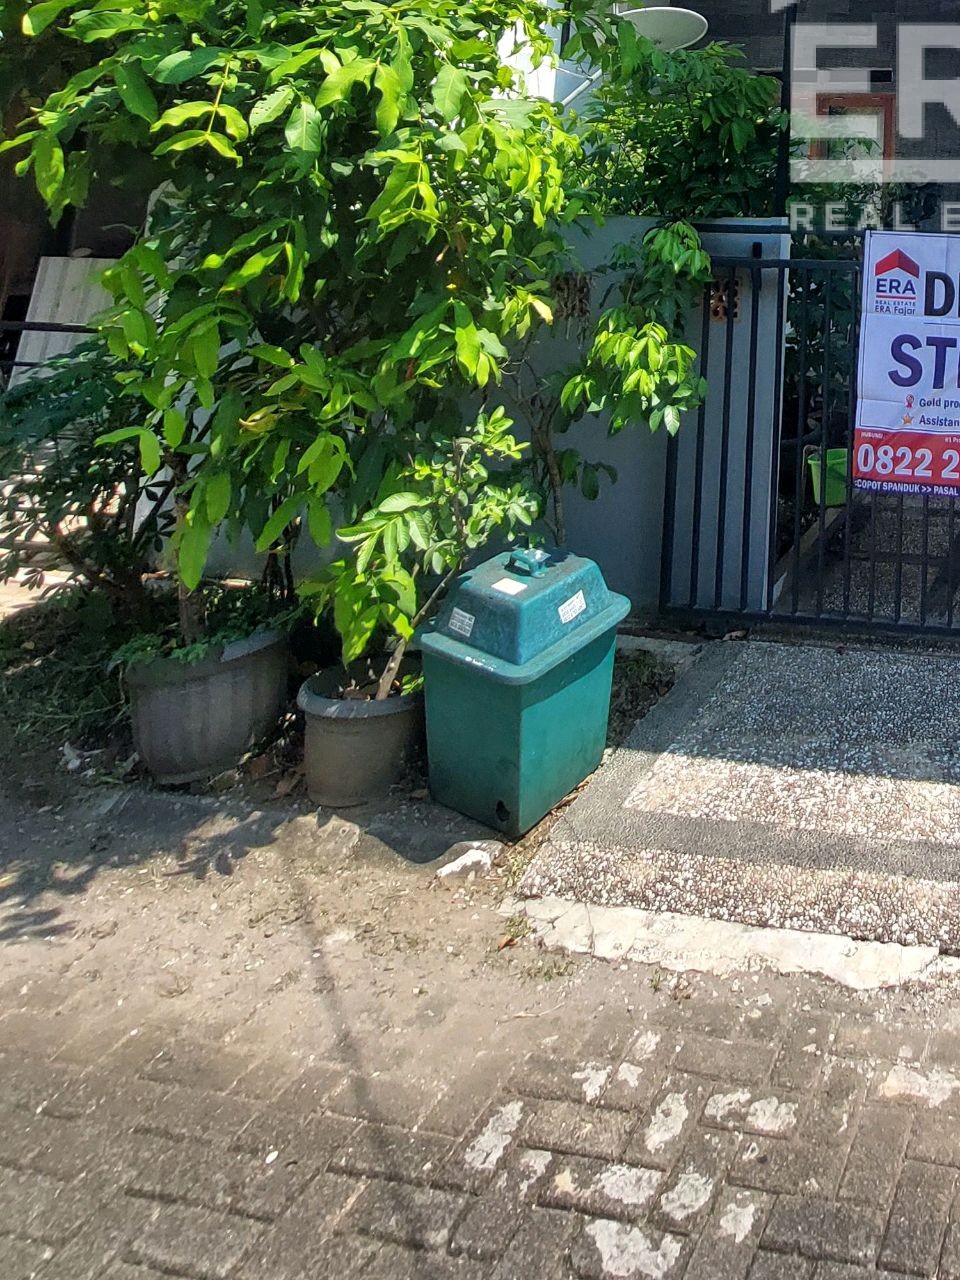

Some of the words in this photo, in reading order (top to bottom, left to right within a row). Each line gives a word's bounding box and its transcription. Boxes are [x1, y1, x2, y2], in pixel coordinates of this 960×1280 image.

[876, 278, 916, 295] ERA
[875, 305, 891, 313] ERA
[894, 306, 915, 316] Fajar
[919, 398, 941, 408] Gold
[857, 443, 933, 477] 0822
[883, 482, 920, 493] SPANDUK
[933, 486, 959, 496] PASAL
